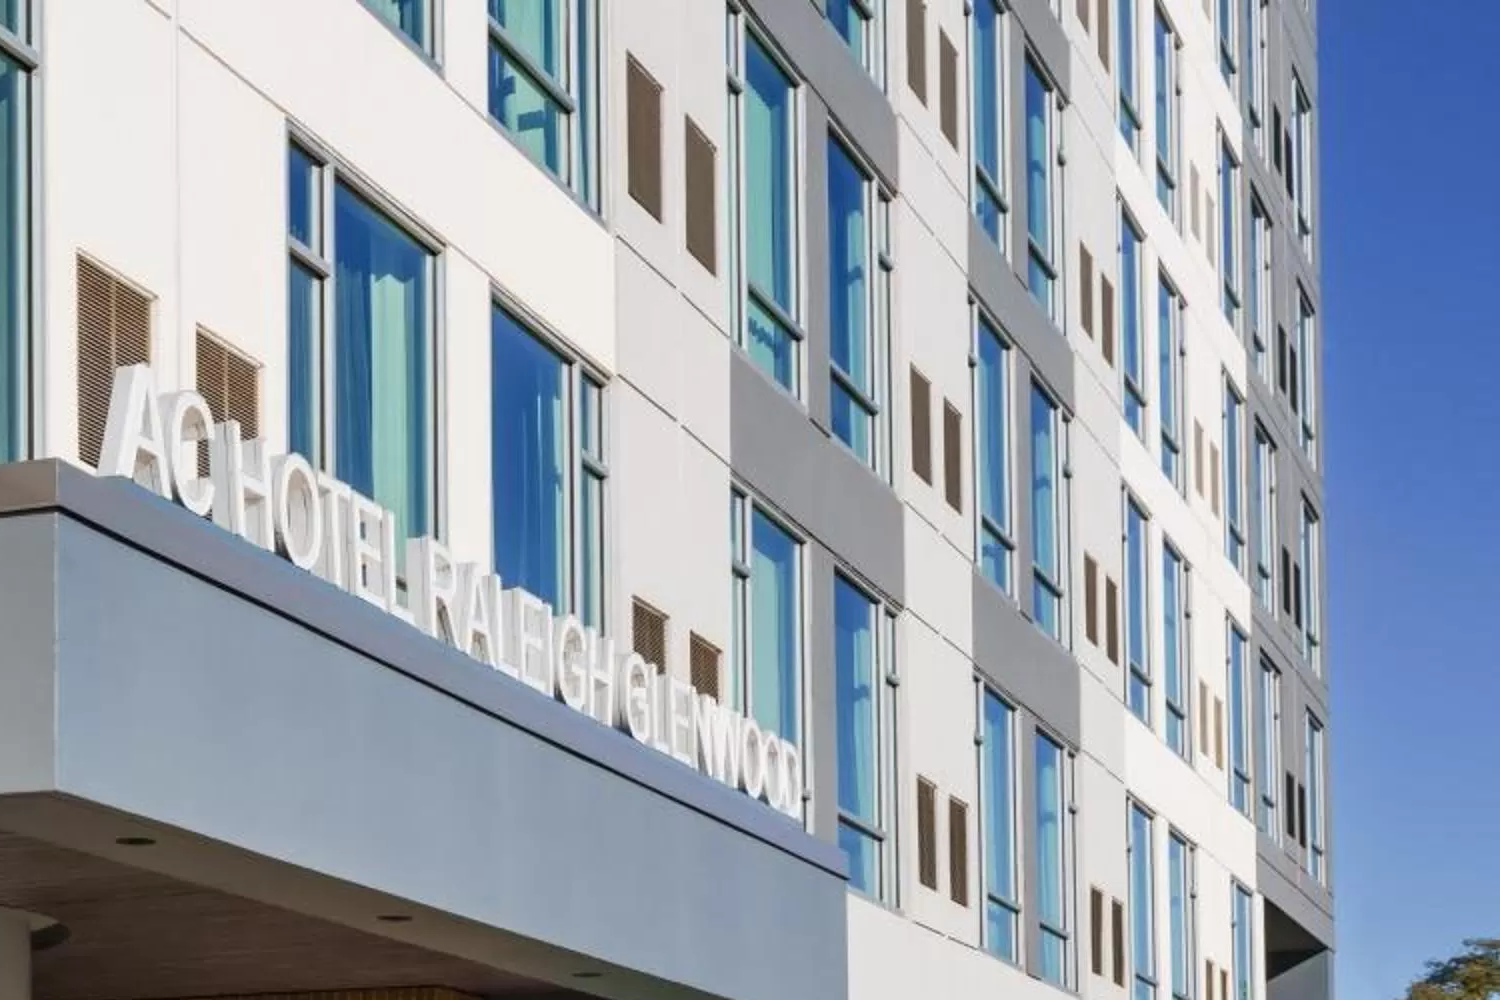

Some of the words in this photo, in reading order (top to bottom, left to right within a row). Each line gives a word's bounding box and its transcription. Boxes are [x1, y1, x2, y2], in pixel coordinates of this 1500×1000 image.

[99, 363, 215, 516] AC
[214, 418, 414, 626] HOTEL
[408, 535, 614, 728] RALEIGH
[622, 652, 802, 822] GLENWOOD
